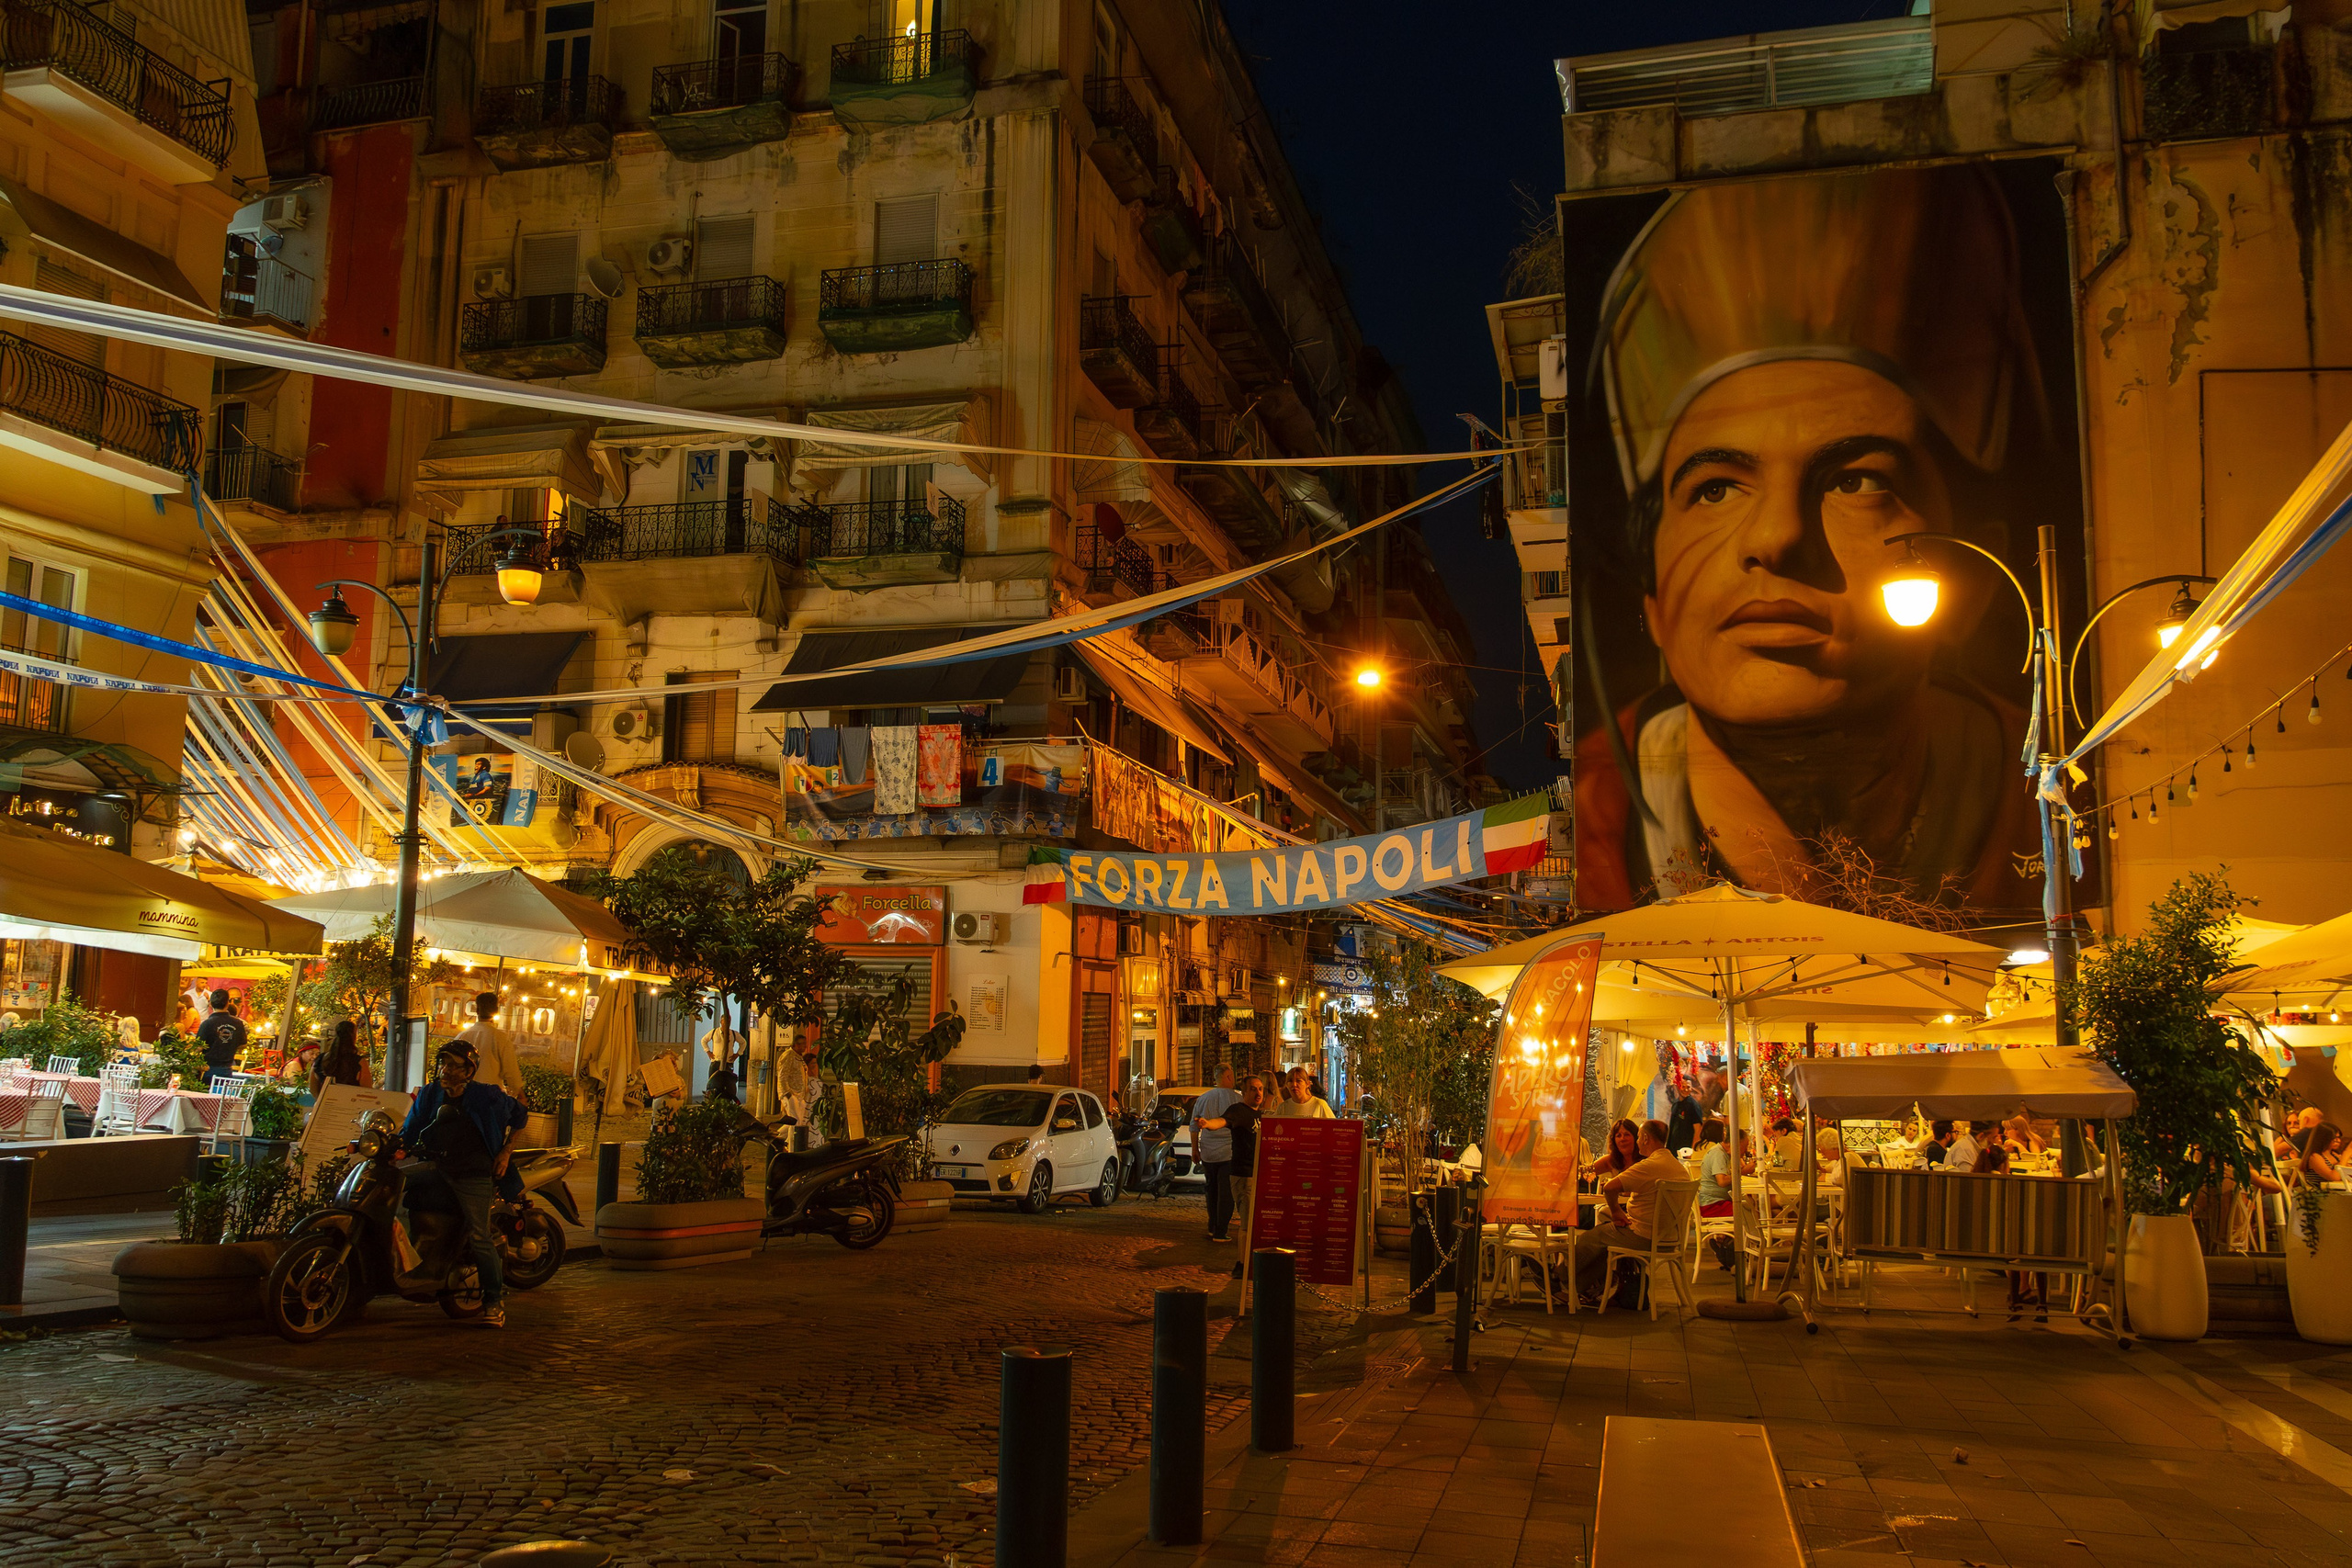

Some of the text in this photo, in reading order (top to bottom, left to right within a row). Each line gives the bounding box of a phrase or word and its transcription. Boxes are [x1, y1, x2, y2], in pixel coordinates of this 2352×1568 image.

[832, 773, 839, 781] 2
[981, 757, 999, 785] 4
[1069, 818, 1474, 909] FORZA NAPOLI
[863, 895, 932, 910] Forcella
[139, 910, 199, 928] mammina
[1602, 936, 1825, 948] STELLA ARTOIS
[1497, 1055, 1585, 1098] APEROL
